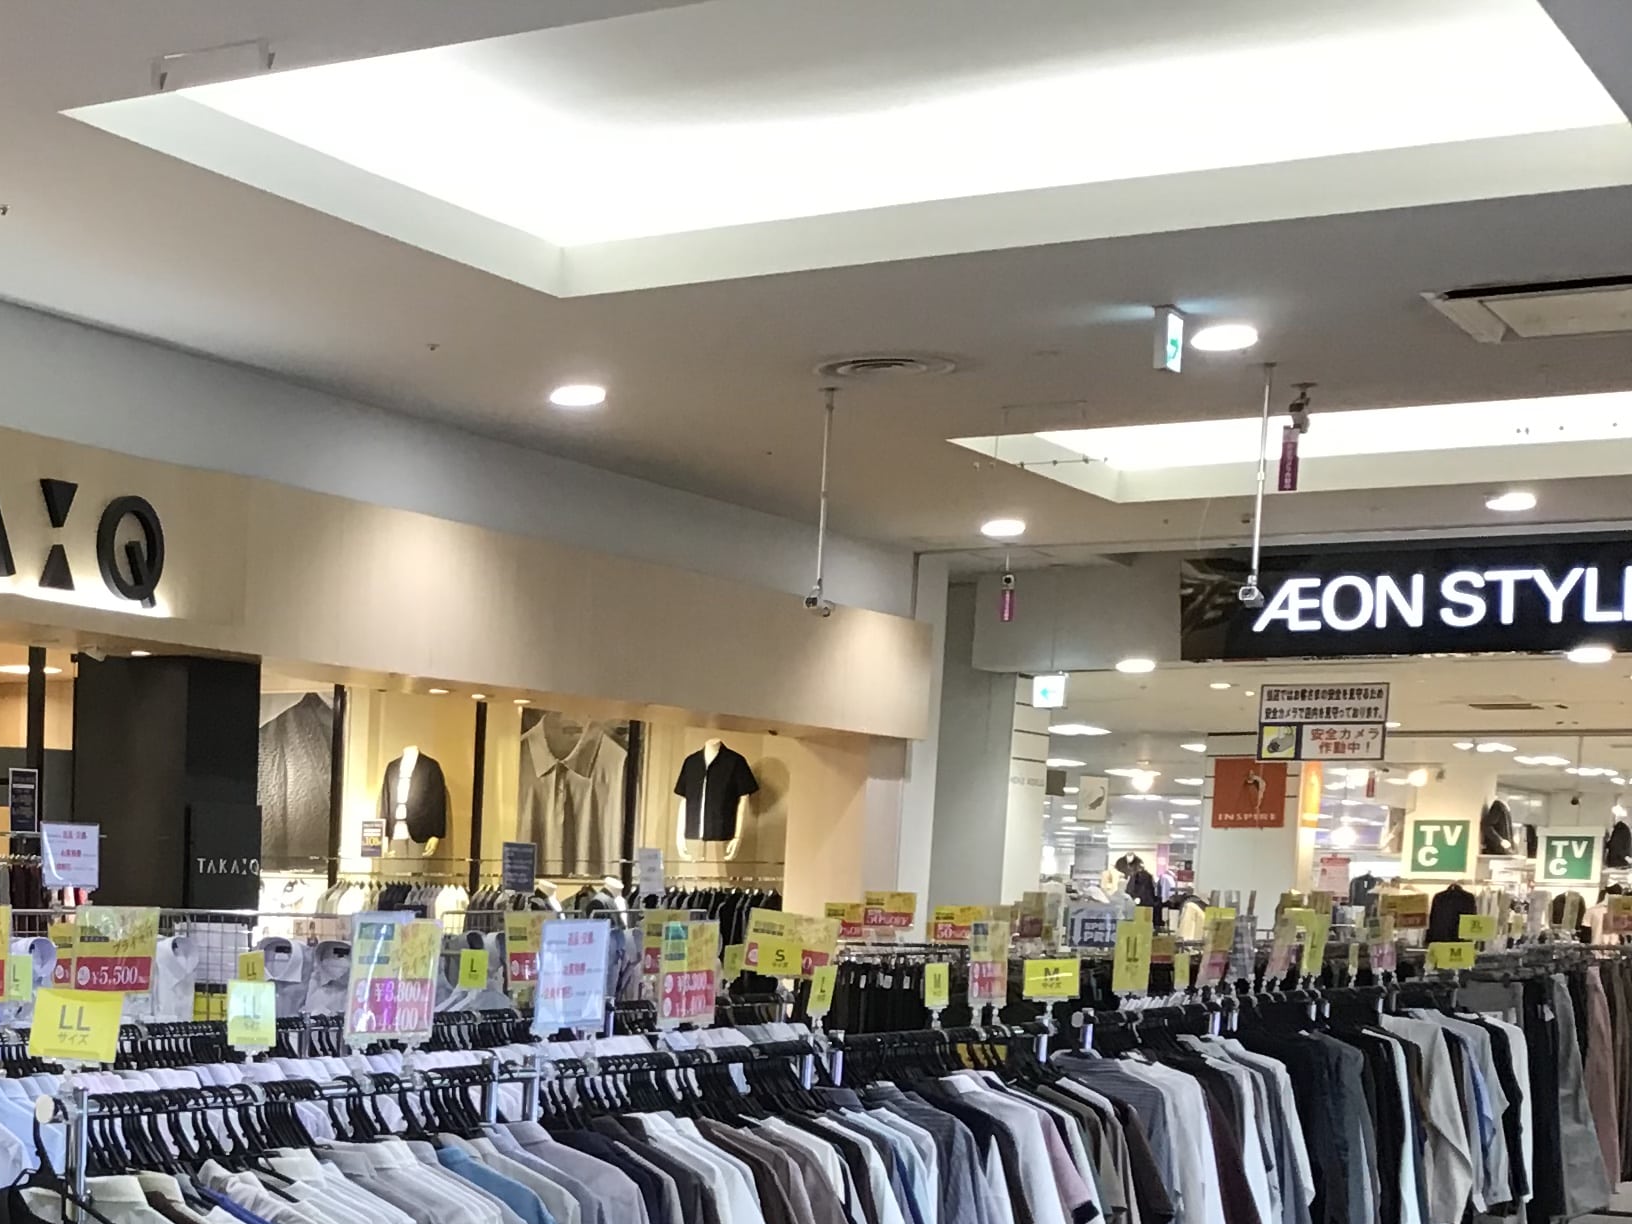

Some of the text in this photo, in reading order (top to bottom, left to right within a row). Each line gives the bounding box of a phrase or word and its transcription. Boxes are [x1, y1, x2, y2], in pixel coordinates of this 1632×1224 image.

[1310, 727, 1380, 741] 安全カメラ
[775, 949, 786, 962] S
[470, 958, 477, 973] L
[92, 965, 139, 985] ¥5,500
[1044, 967, 1060, 982] M
[58, 1004, 91, 1032] LL
[57, 1032, 89, 1046] サイズ
